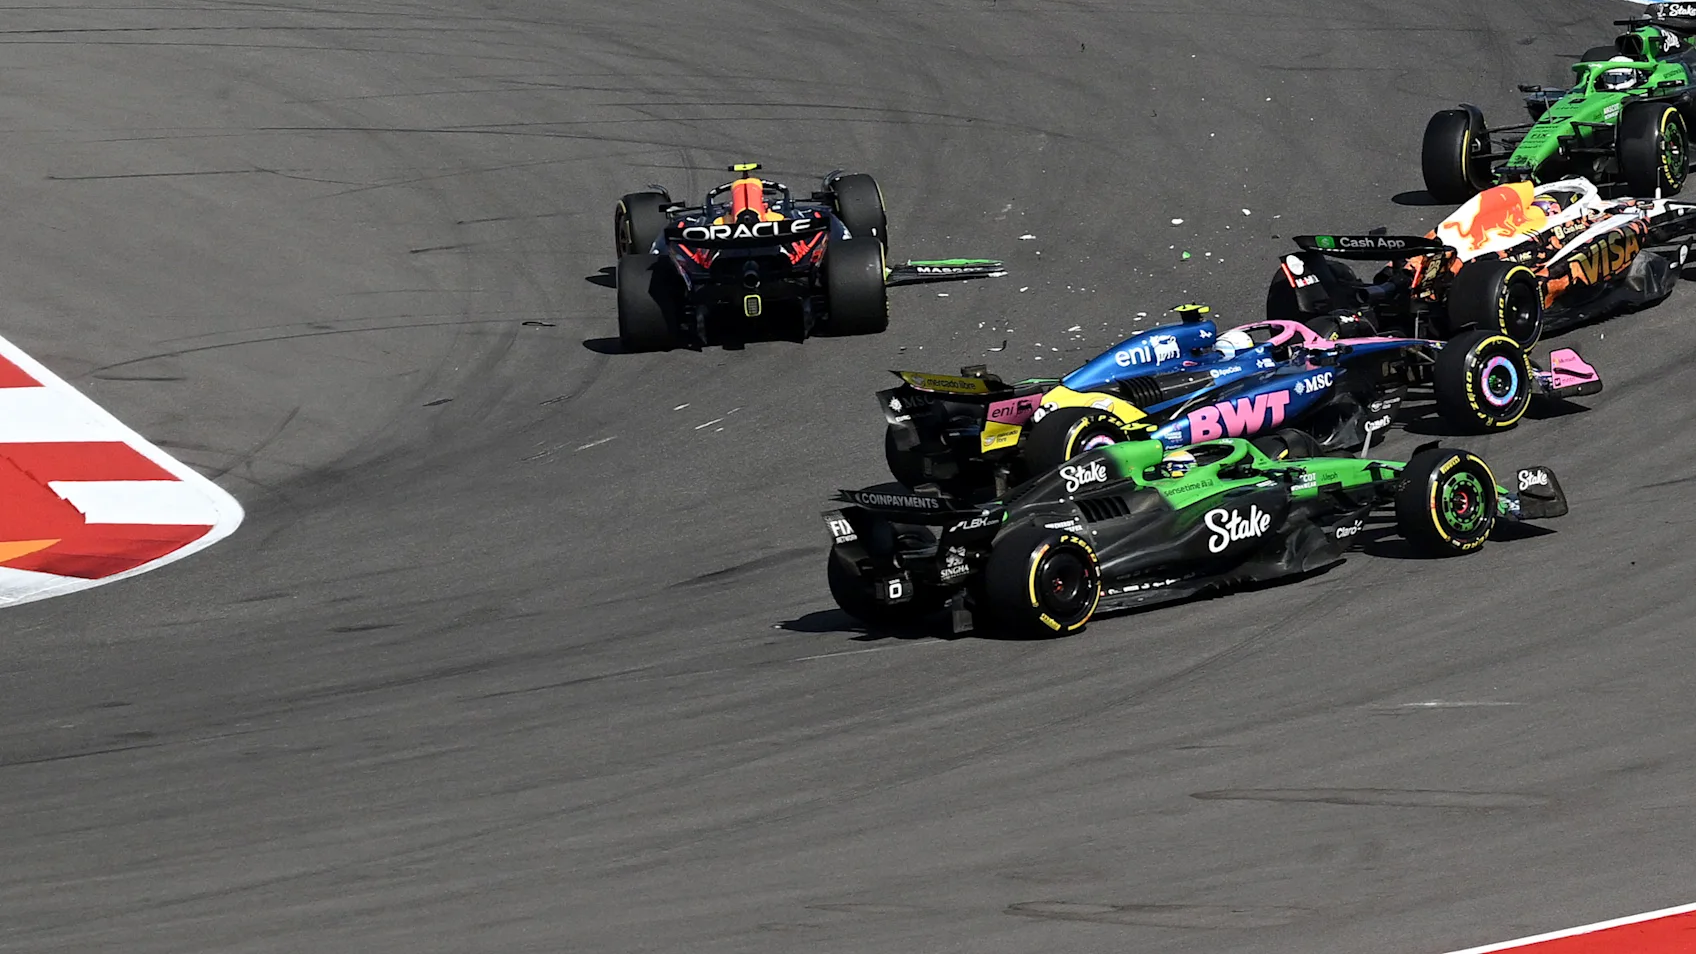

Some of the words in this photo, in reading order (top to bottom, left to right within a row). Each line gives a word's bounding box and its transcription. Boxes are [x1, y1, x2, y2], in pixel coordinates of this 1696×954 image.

[1669, 3, 1696, 17] Stake
[682, 218, 811, 240] ORACLE
[1339, 236, 1375, 248] Cash
[1377, 237, 1405, 249] App
[1567, 228, 1640, 285] VISA
[1114, 339, 1152, 368] eni
[1305, 371, 1334, 393] MSC
[991, 404, 1016, 419] eni
[1187, 389, 1291, 445] BWT
[1059, 461, 1108, 493] Stake
[1518, 469, 1548, 492] Stake
[1163, 481, 1201, 496] sensetime
[862, 492, 940, 509] COINPAYMENTS
[830, 518, 855, 537] FIX
[1203, 504, 1272, 554] Stake
[1335, 525, 1357, 539] Claro
[940, 564, 970, 578] SINGHA
